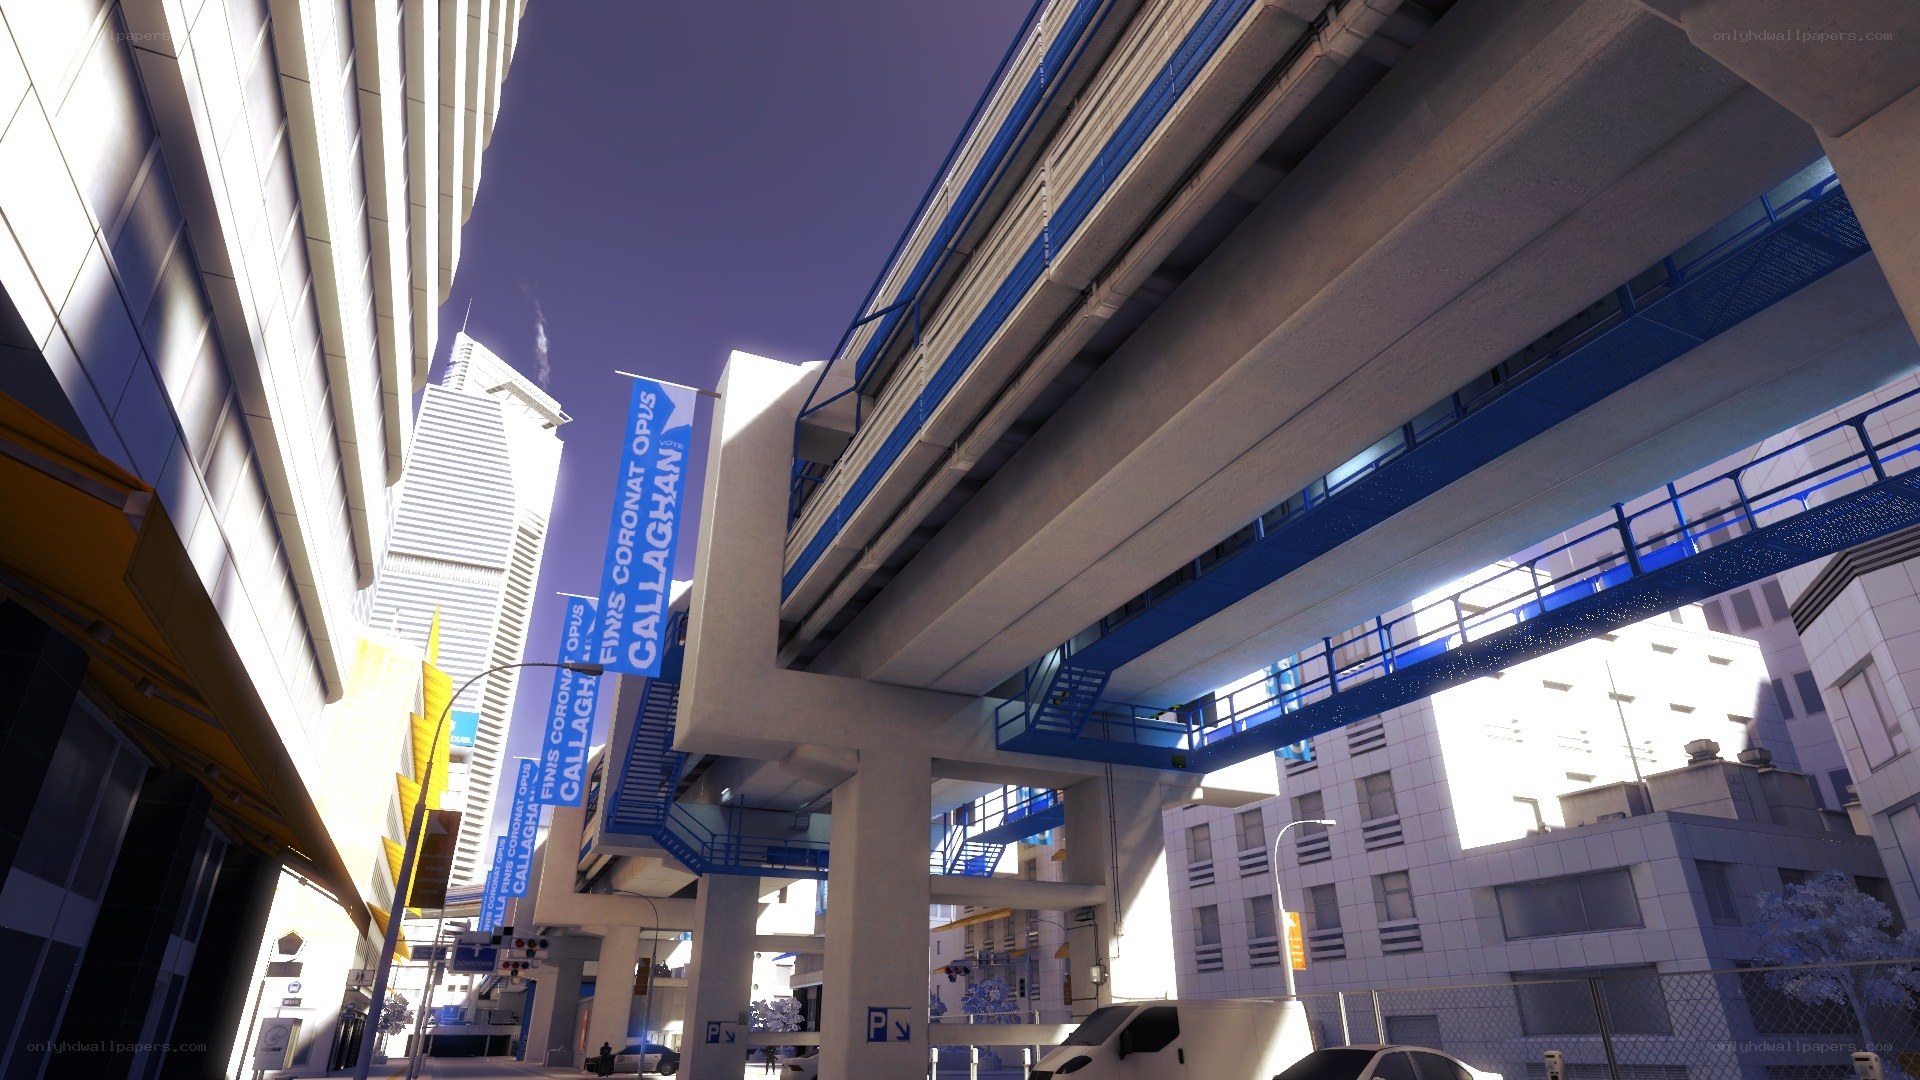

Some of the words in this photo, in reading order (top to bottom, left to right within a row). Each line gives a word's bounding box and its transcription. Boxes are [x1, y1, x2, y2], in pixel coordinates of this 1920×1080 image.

[632, 390, 656, 456] OPUS
[659, 440, 684, 449] VOTE
[612, 462, 646, 586] CORONAT
[628, 448, 683, 670] CALLAGHAN
[599, 590, 626, 664] FINIS
[541, 749, 559, 800] FINIS
[566, 604, 585, 652] OPUS
[519, 763, 532, 796] OPUS
[507, 799, 525, 858] CORONAT
[487, 866, 500, 909] CORONAT
[496, 839, 506, 863] OPUS
[501, 860, 514, 893] FINIS
[708, 1024, 720, 1041] P
[870, 1012, 886, 1039] P
